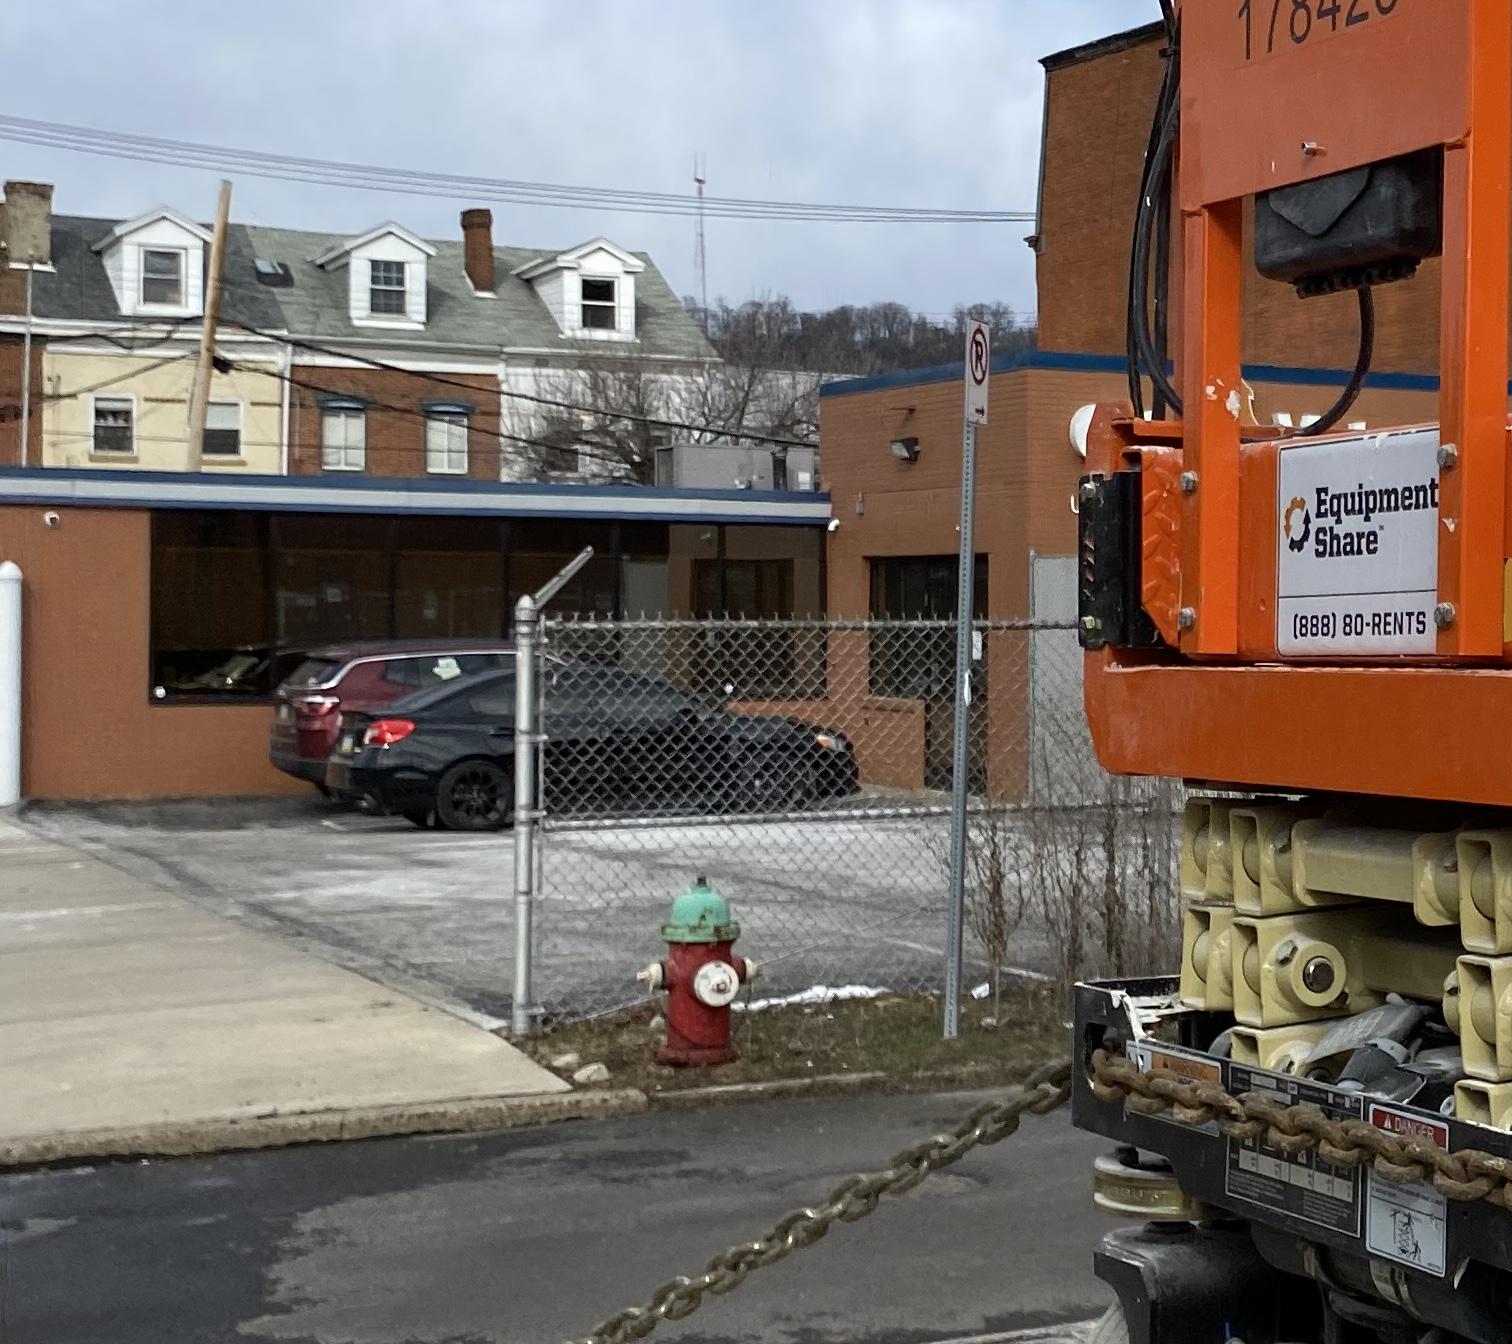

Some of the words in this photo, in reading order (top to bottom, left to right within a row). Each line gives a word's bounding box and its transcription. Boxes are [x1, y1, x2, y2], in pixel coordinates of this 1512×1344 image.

[1315, 477, 1439, 525] Equipment
[1314, 524, 1379, 558] Share
[1293, 612, 1337, 640] (888)
[1342, 611, 1427, 637] 80-RENTS
